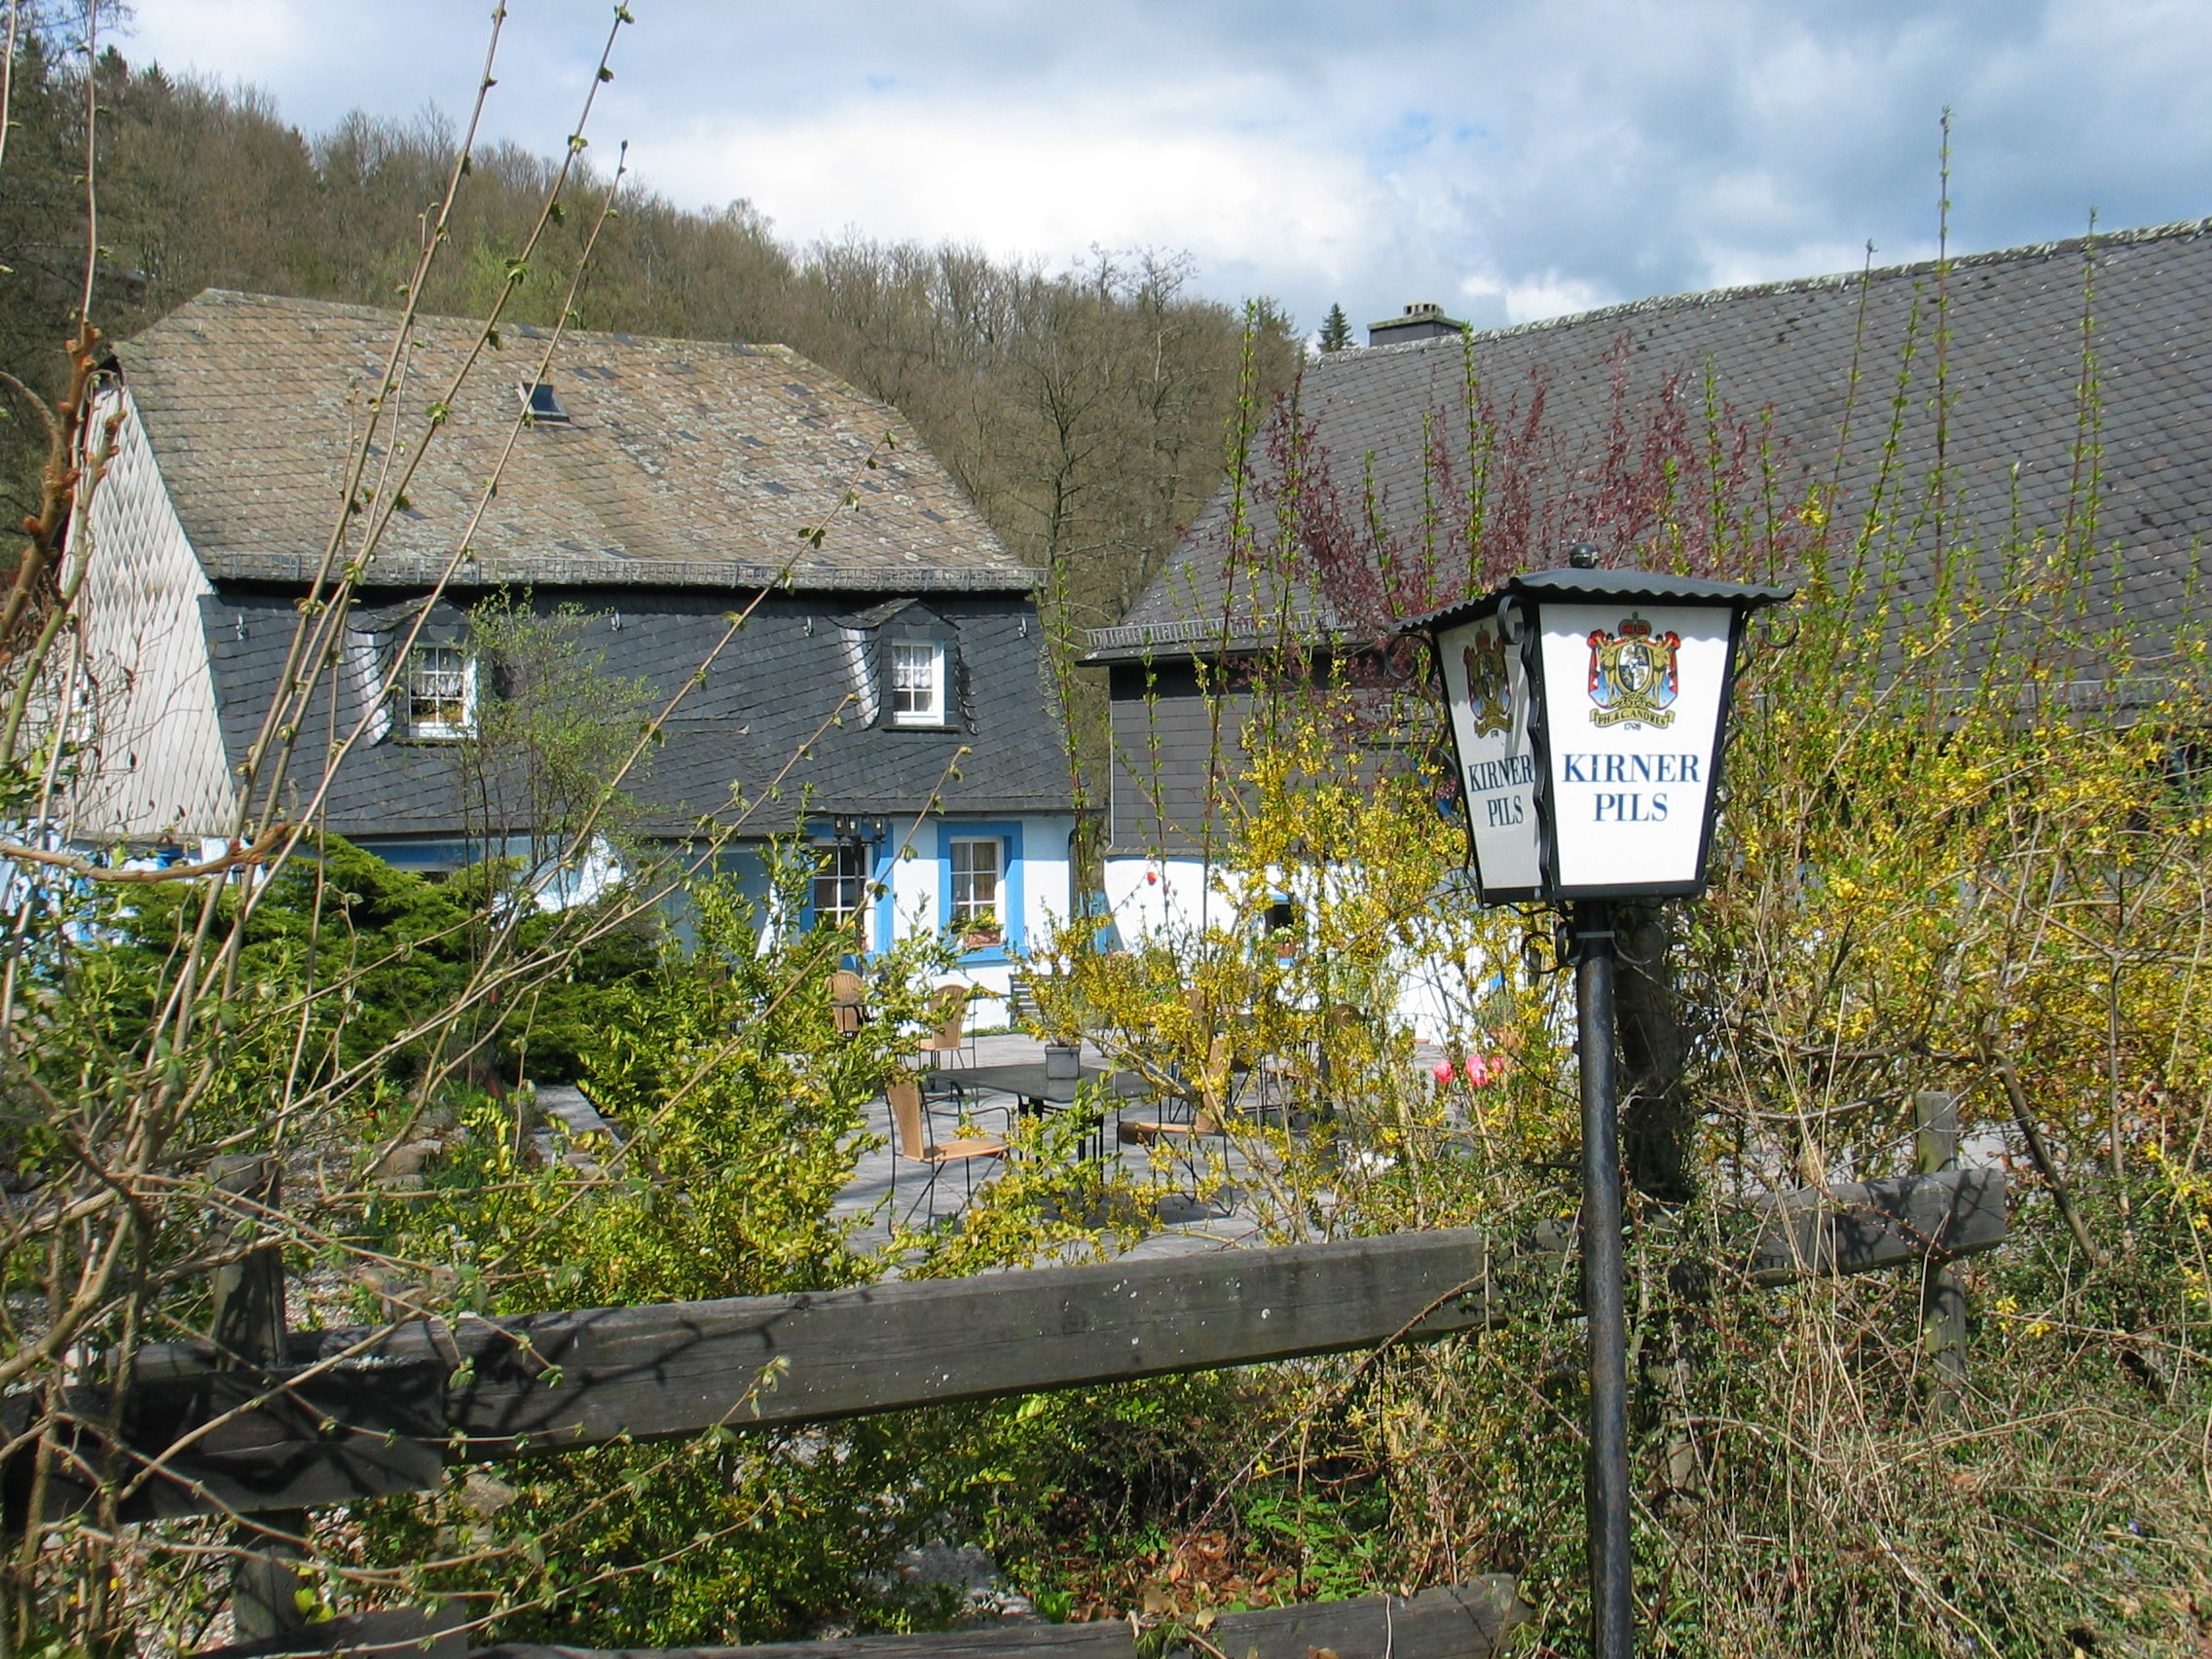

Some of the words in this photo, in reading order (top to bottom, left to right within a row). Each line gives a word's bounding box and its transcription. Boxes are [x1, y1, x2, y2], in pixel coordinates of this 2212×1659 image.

[1468, 755, 1534, 793] KIRNER
[1562, 754, 1701, 783] KIRNER
[1487, 794, 1525, 828] PILS
[1593, 793, 1669, 822] PILS
